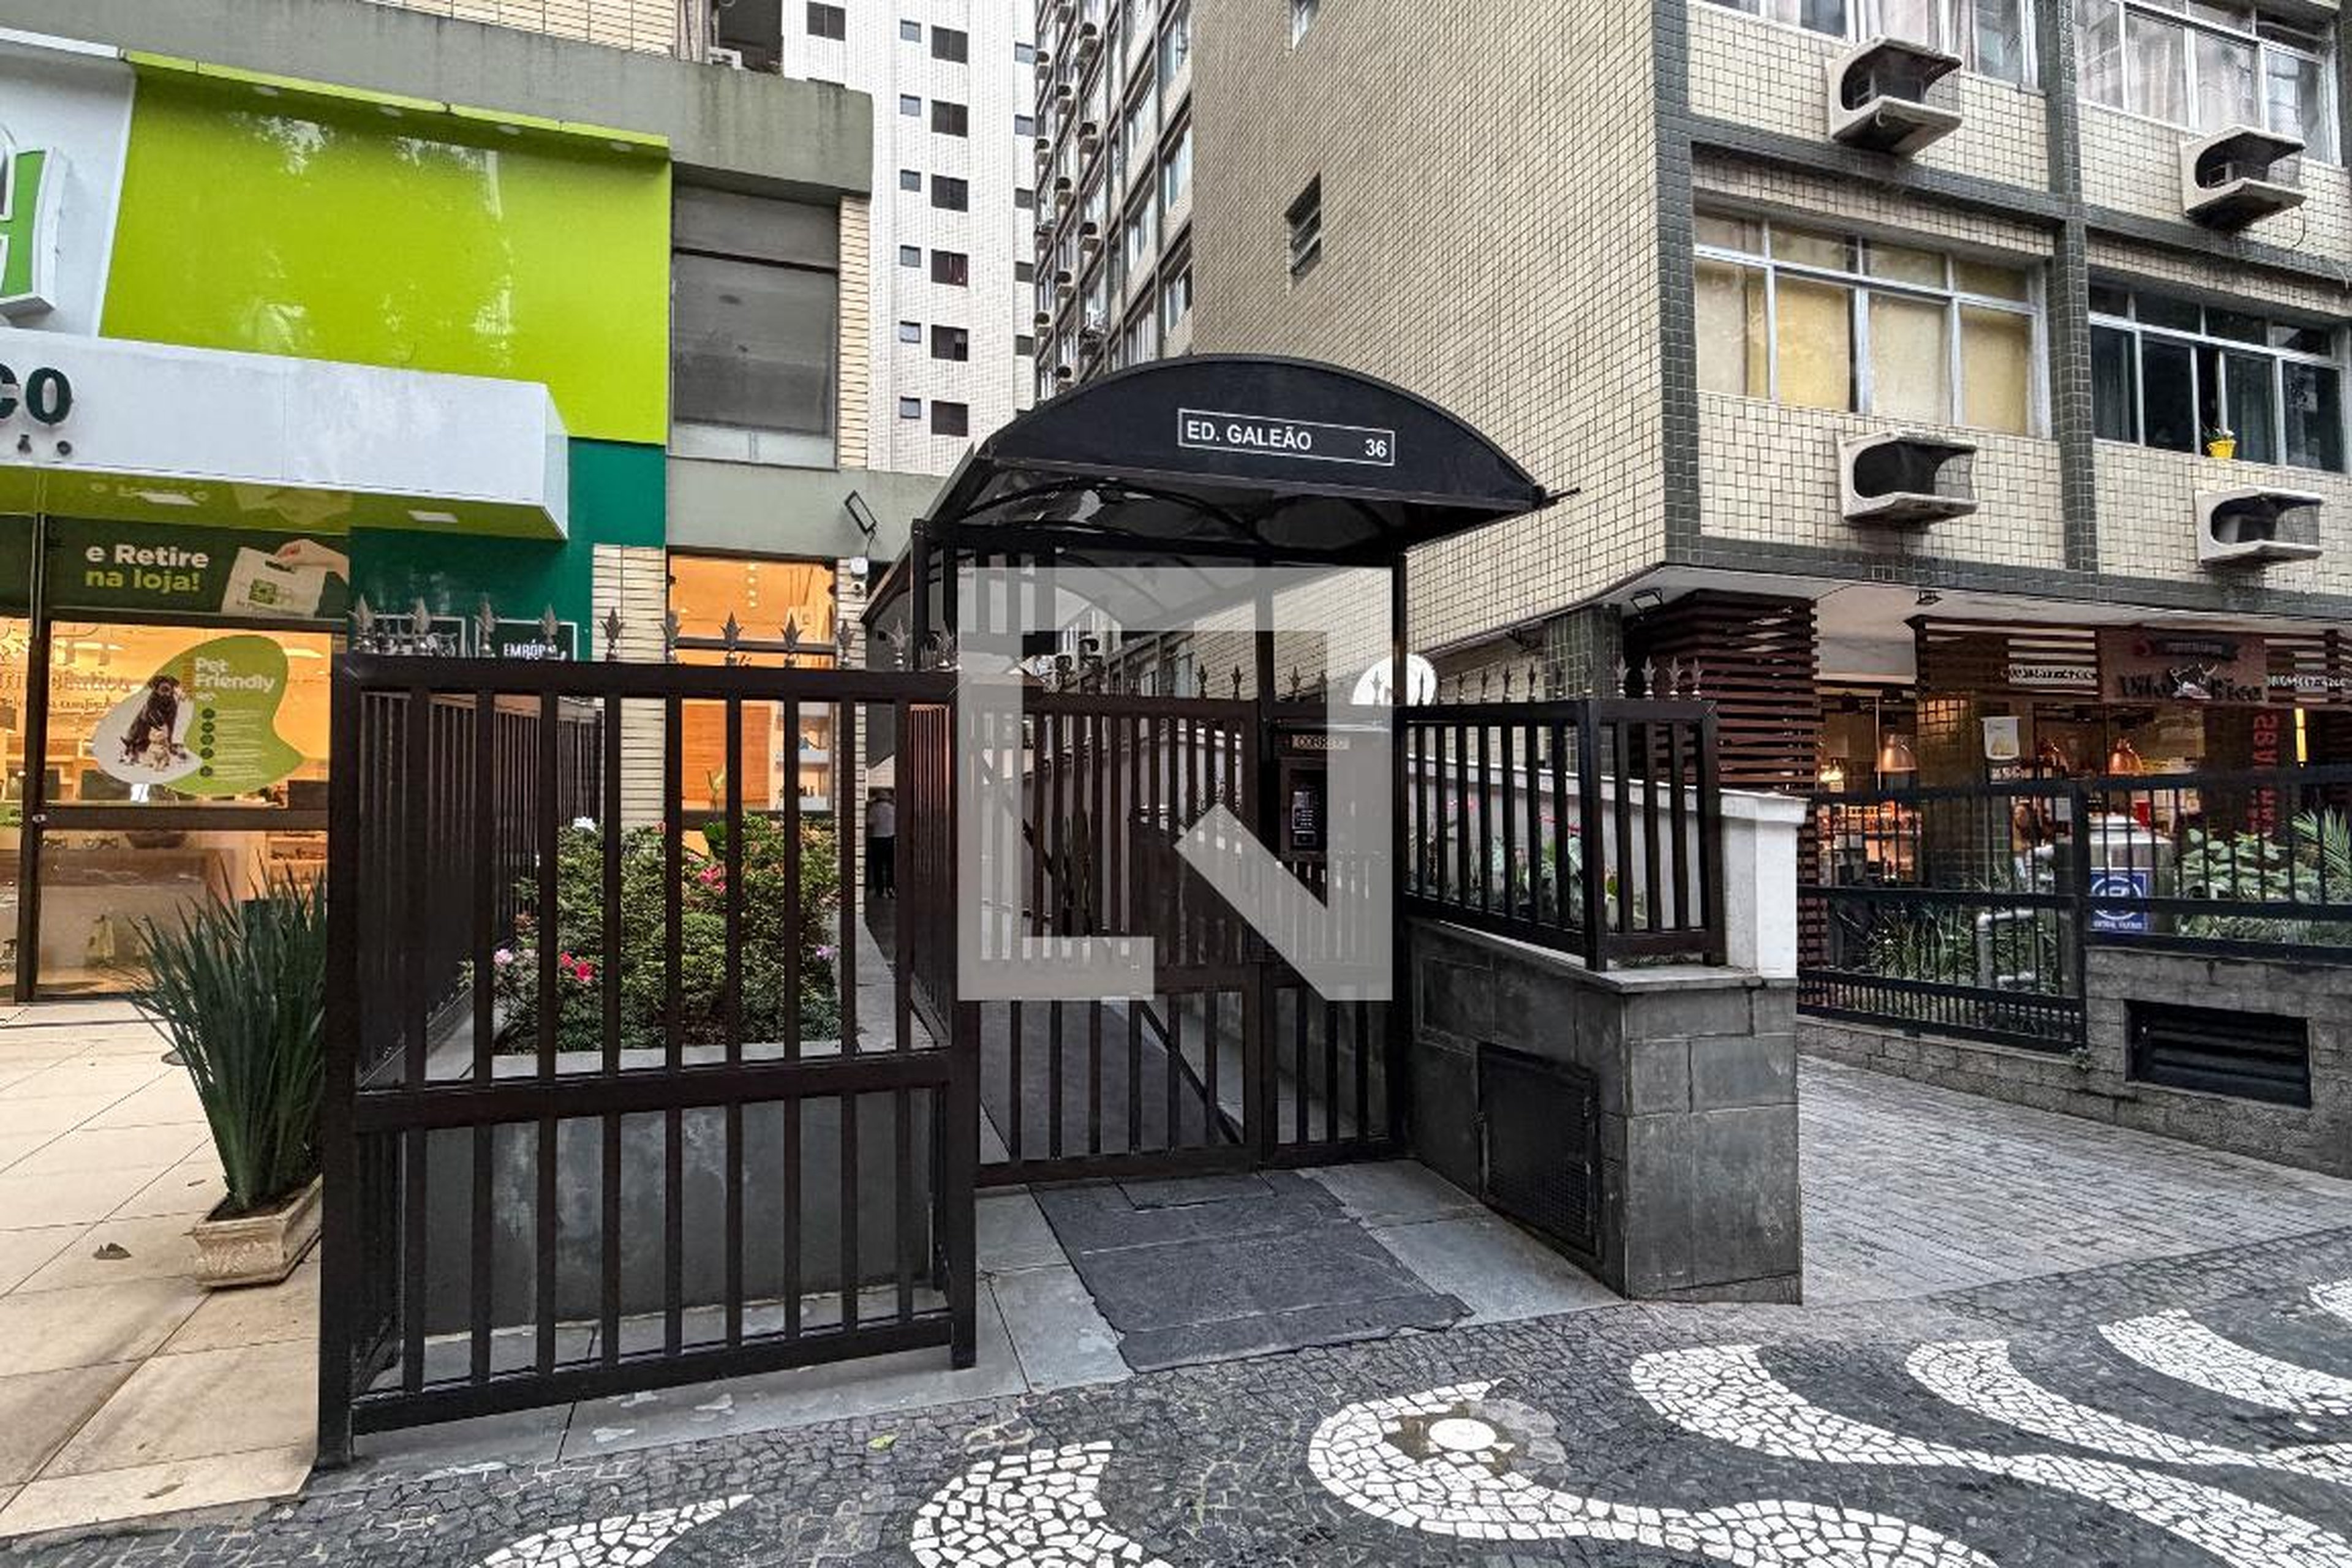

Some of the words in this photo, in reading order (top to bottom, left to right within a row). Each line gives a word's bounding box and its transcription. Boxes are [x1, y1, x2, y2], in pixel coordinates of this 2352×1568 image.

[1186, 420, 1221, 442] ED.
[1227, 424, 1312, 450] GALEÃO
[1365, 438, 1387, 458] 36
[86, 546, 105, 562] e
[115, 544, 209, 568] Retire
[86, 571, 123, 587] na
[134, 569, 200, 594] loja!
[195, 657, 228, 673] Pet
[195, 673, 275, 693] Friendly
